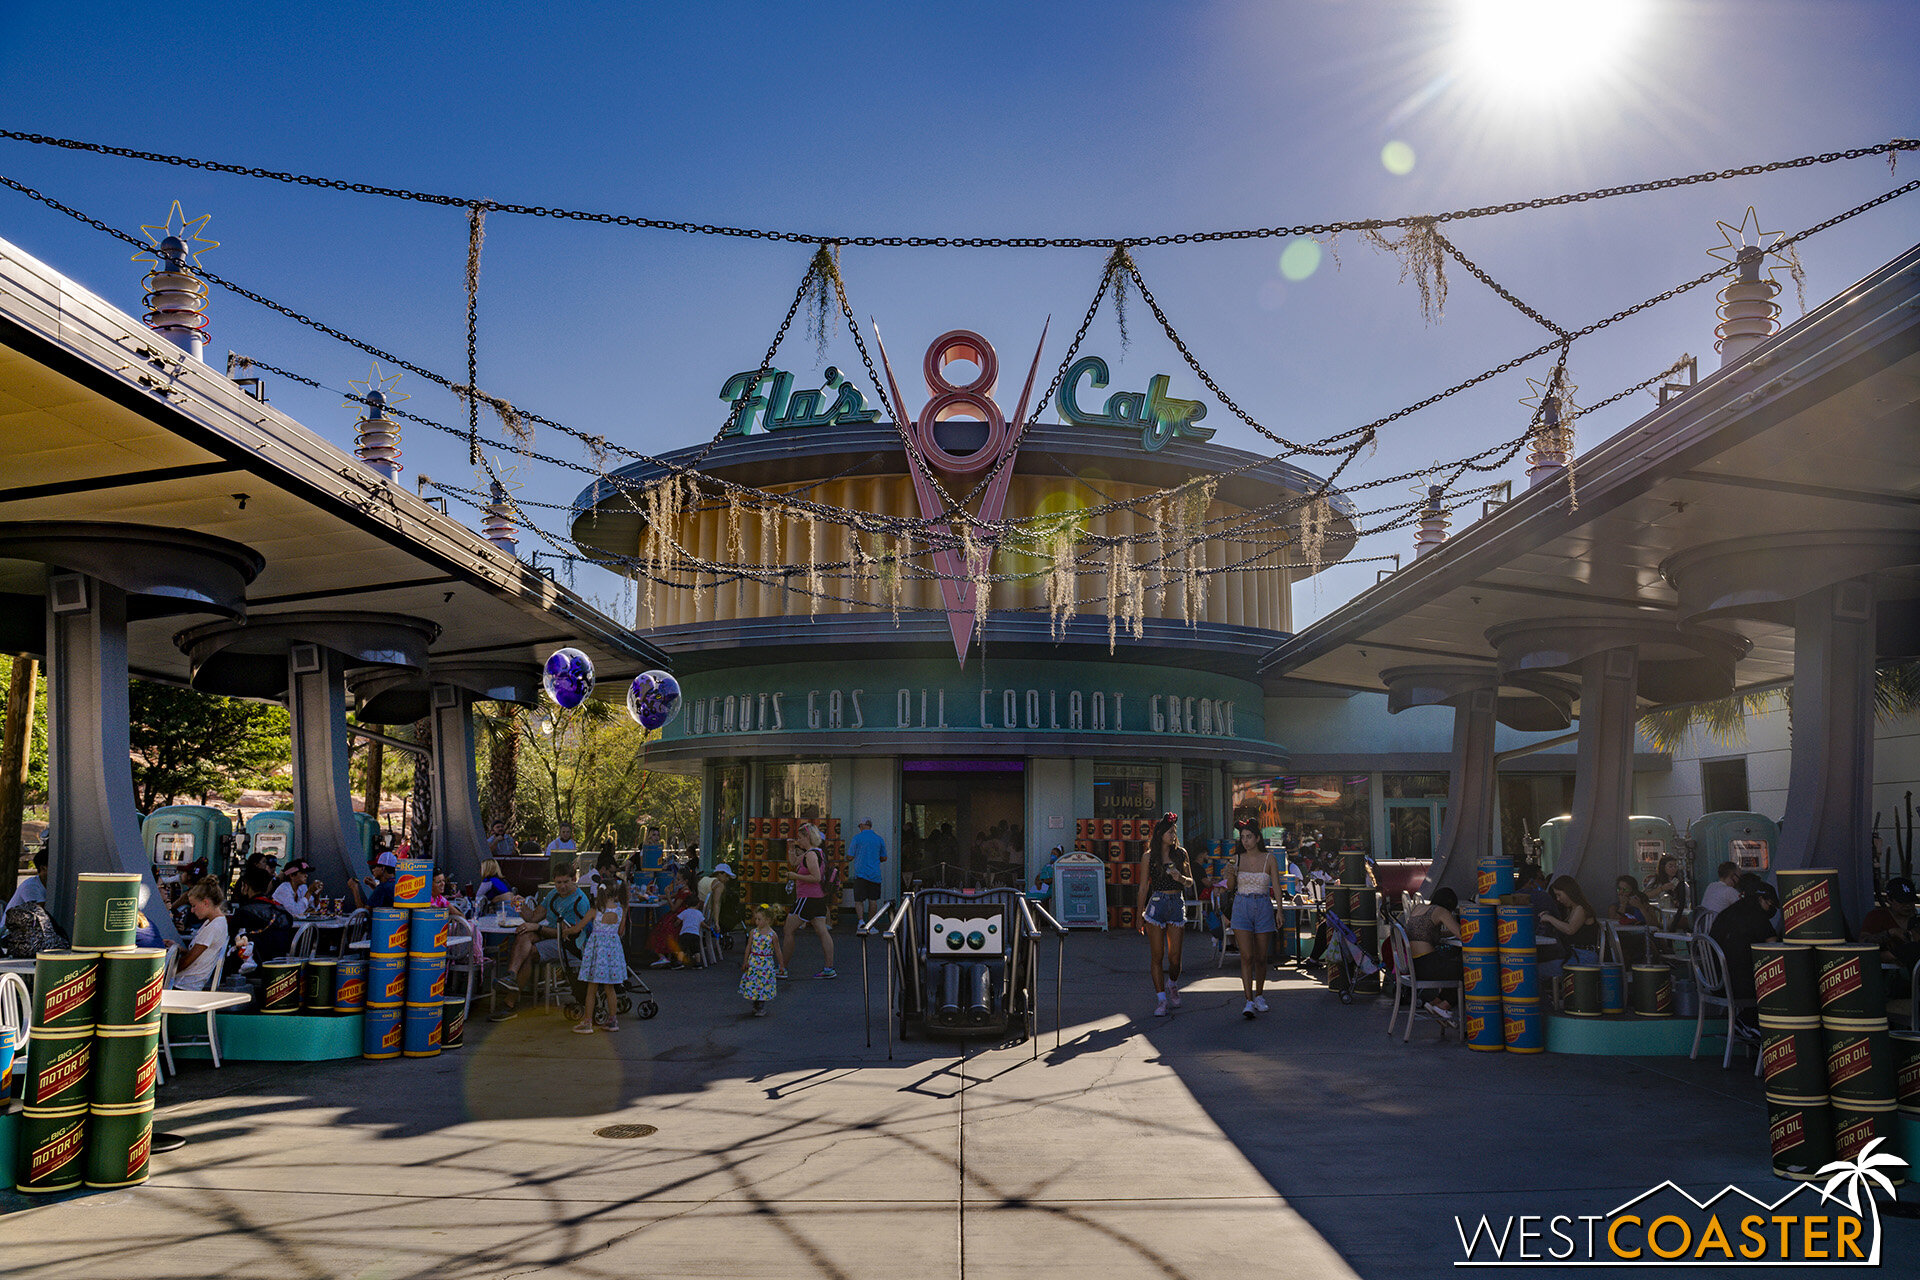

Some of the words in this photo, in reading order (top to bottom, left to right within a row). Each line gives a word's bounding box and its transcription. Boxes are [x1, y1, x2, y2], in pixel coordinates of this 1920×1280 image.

[720, 367, 882, 438] Flo's
[1056, 356, 1217, 452] Cafe
[808, 690, 863, 729] GAS
[897, 689, 948, 729] OIL
[980, 689, 1124, 731] COOLANT
[1150, 694, 1236, 737] GREASE
[1102, 795, 1153, 808] JUMBO
[1792, 884, 1805, 896] BIG
[1783, 895, 1812, 921] MOTOR
[1814, 887, 1828, 903] OIL
[63, 970, 79, 983] BIG
[345, 966, 360, 975] BIG
[1769, 964, 1784, 979] OIL
[1843, 965, 1859, 980] OIL
[46, 981, 84, 1009] MOTOR
[85, 972, 97, 988] OIL
[338, 985, 359, 998] MOTOR
[1780, 1043, 1795, 1058] OIL
[1832, 1040, 1844, 1052] BIG
[1853, 1046, 1870, 1061] OIL
[57, 1048, 73, 1062] BIG
[40, 1060, 78, 1089] MOTOR
[79, 1050, 90, 1067] OIL
[1899, 1068, 1920, 1087] MOT
[50, 1127, 66, 1142] BIG
[1787, 1120, 1802, 1135] OIL
[1857, 1125, 1873, 1141] OIL
[33, 1138, 71, 1169] MOTOR
[72, 1128, 84, 1145] OIL
